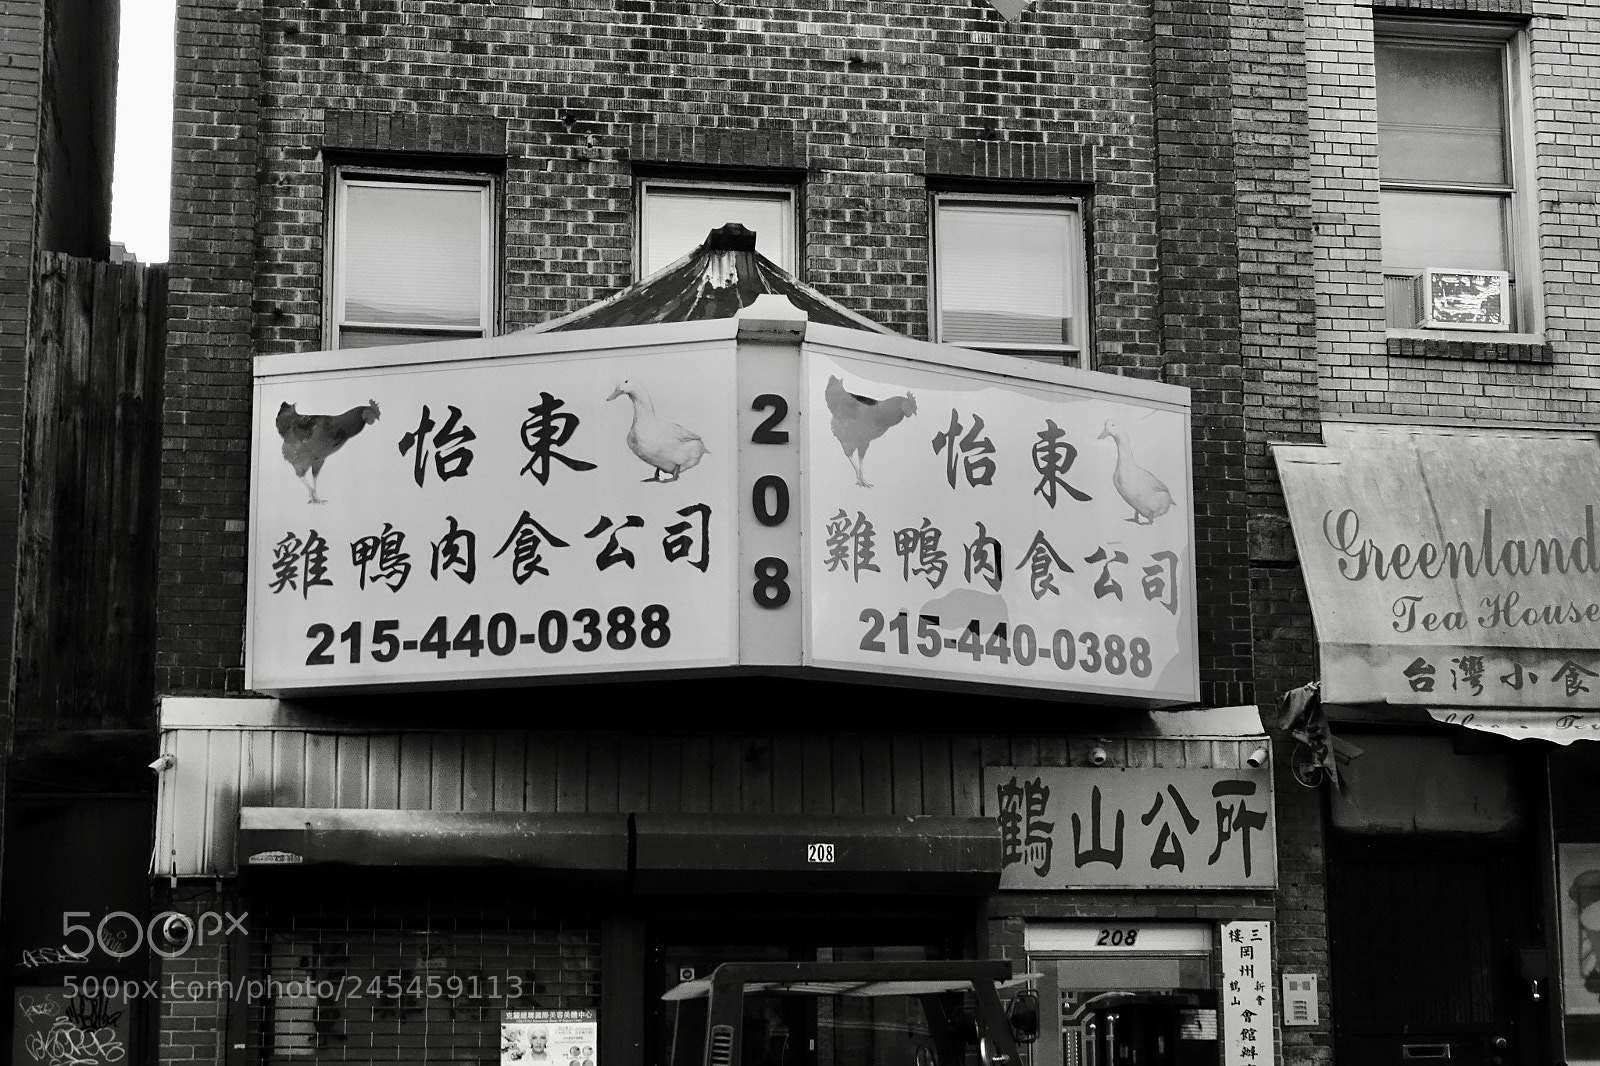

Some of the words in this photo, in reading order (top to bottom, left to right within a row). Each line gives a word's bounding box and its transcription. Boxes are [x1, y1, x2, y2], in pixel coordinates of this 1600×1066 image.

[399, 391, 598, 489] 怡東
[931, 408, 1092, 508] 怡東
[751, 394, 792, 610] 208
[268, 502, 713, 600] 雞鴨肉食公司
[823, 508, 1179, 616] 雞鴨肉食公司
[1322, 504, 1600, 582] Greenland
[305, 603, 671, 666] 215-440-0388
[858, 607, 1153, 678] 215-440-0388
[1392, 595, 1468, 633] Tea
[1478, 590, 1600, 630] House
[1402, 655, 1600, 698] 台灣小食
[808, 844, 833, 862] 208
[996, 775, 1269, 879] 鶴山公所
[1096, 929, 1138, 947] 208
